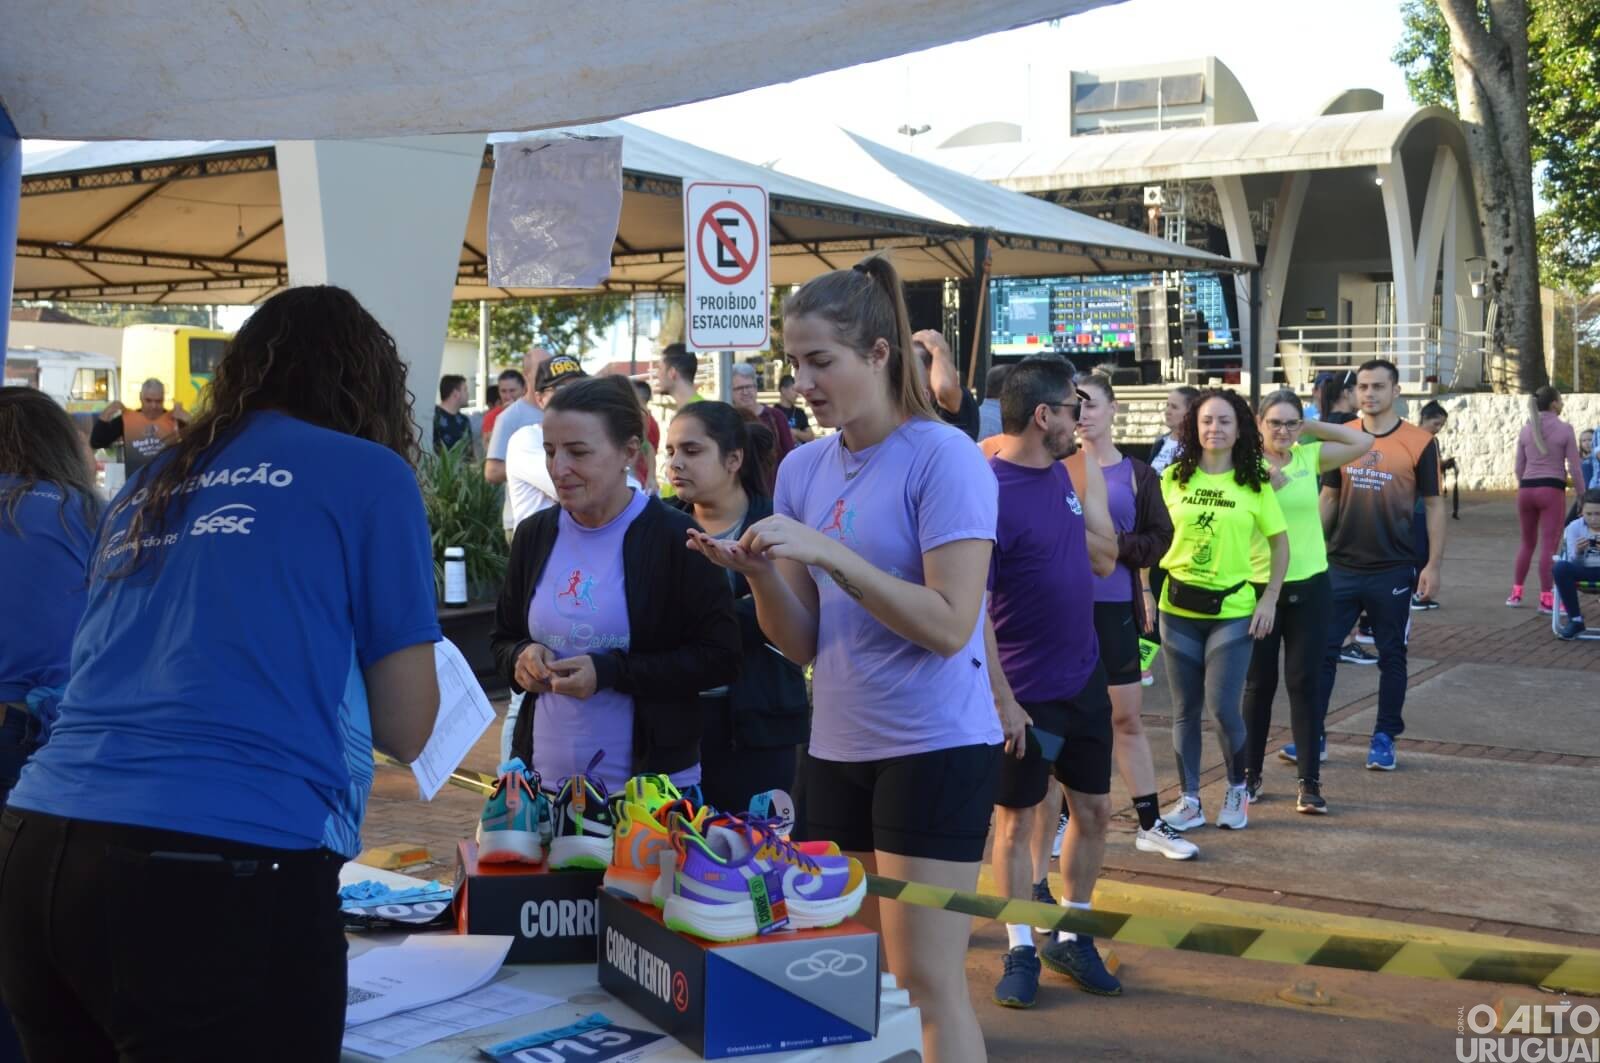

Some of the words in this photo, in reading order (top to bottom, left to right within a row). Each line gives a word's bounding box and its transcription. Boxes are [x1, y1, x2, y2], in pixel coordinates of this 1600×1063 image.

[700, 295, 757, 311] PROIBIDO
[692, 314, 764, 329] ESTACIONAR
[1346, 466, 1364, 476] Med
[1365, 468, 1393, 481] Forma
[1194, 488, 1225, 499] CORRE
[1181, 496, 1236, 509] PALMITINHO
[190, 512, 256, 536] sesc
[520, 899, 599, 938] CORR
[605, 925, 638, 982] CORRE
[638, 945, 671, 1003] VENTO
